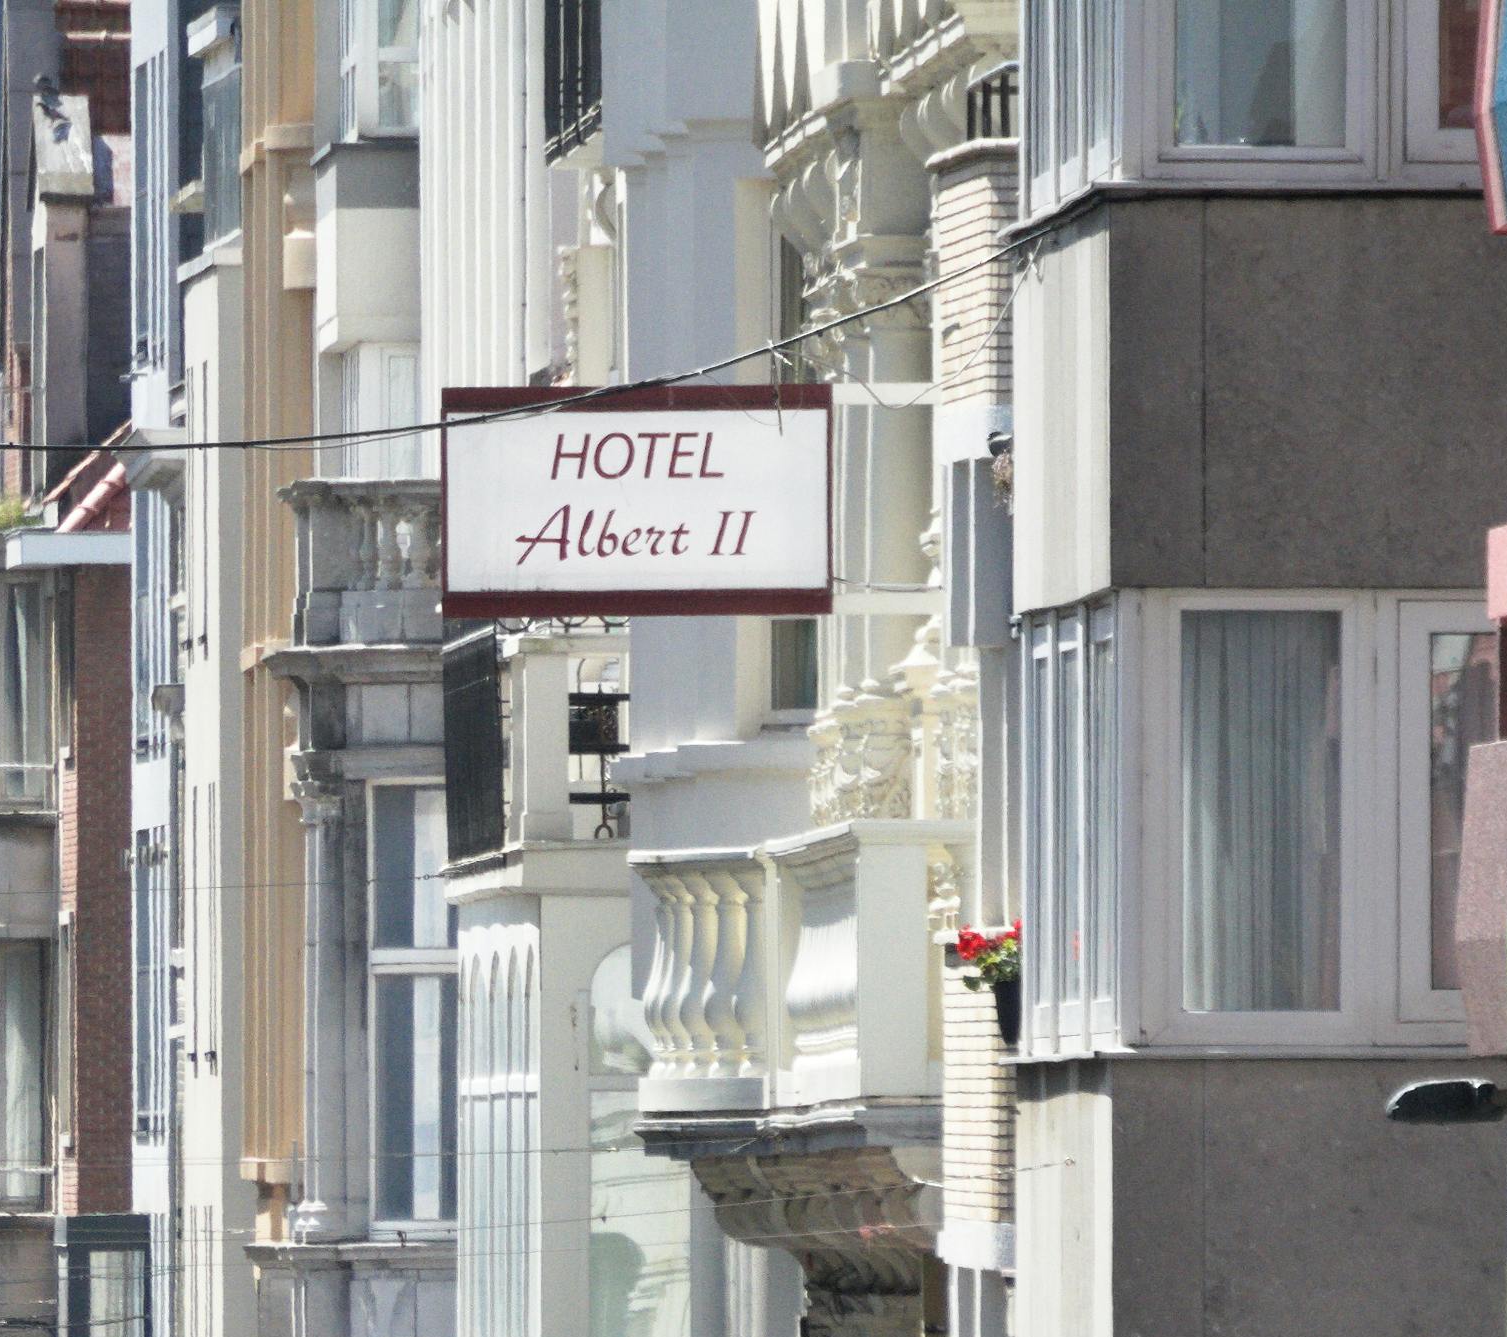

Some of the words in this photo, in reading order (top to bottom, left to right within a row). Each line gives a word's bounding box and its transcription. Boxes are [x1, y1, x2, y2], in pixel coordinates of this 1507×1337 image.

[550, 431, 725, 481] HOTEL
[515, 503, 691, 566] Albert
[706, 510, 757, 557] II
